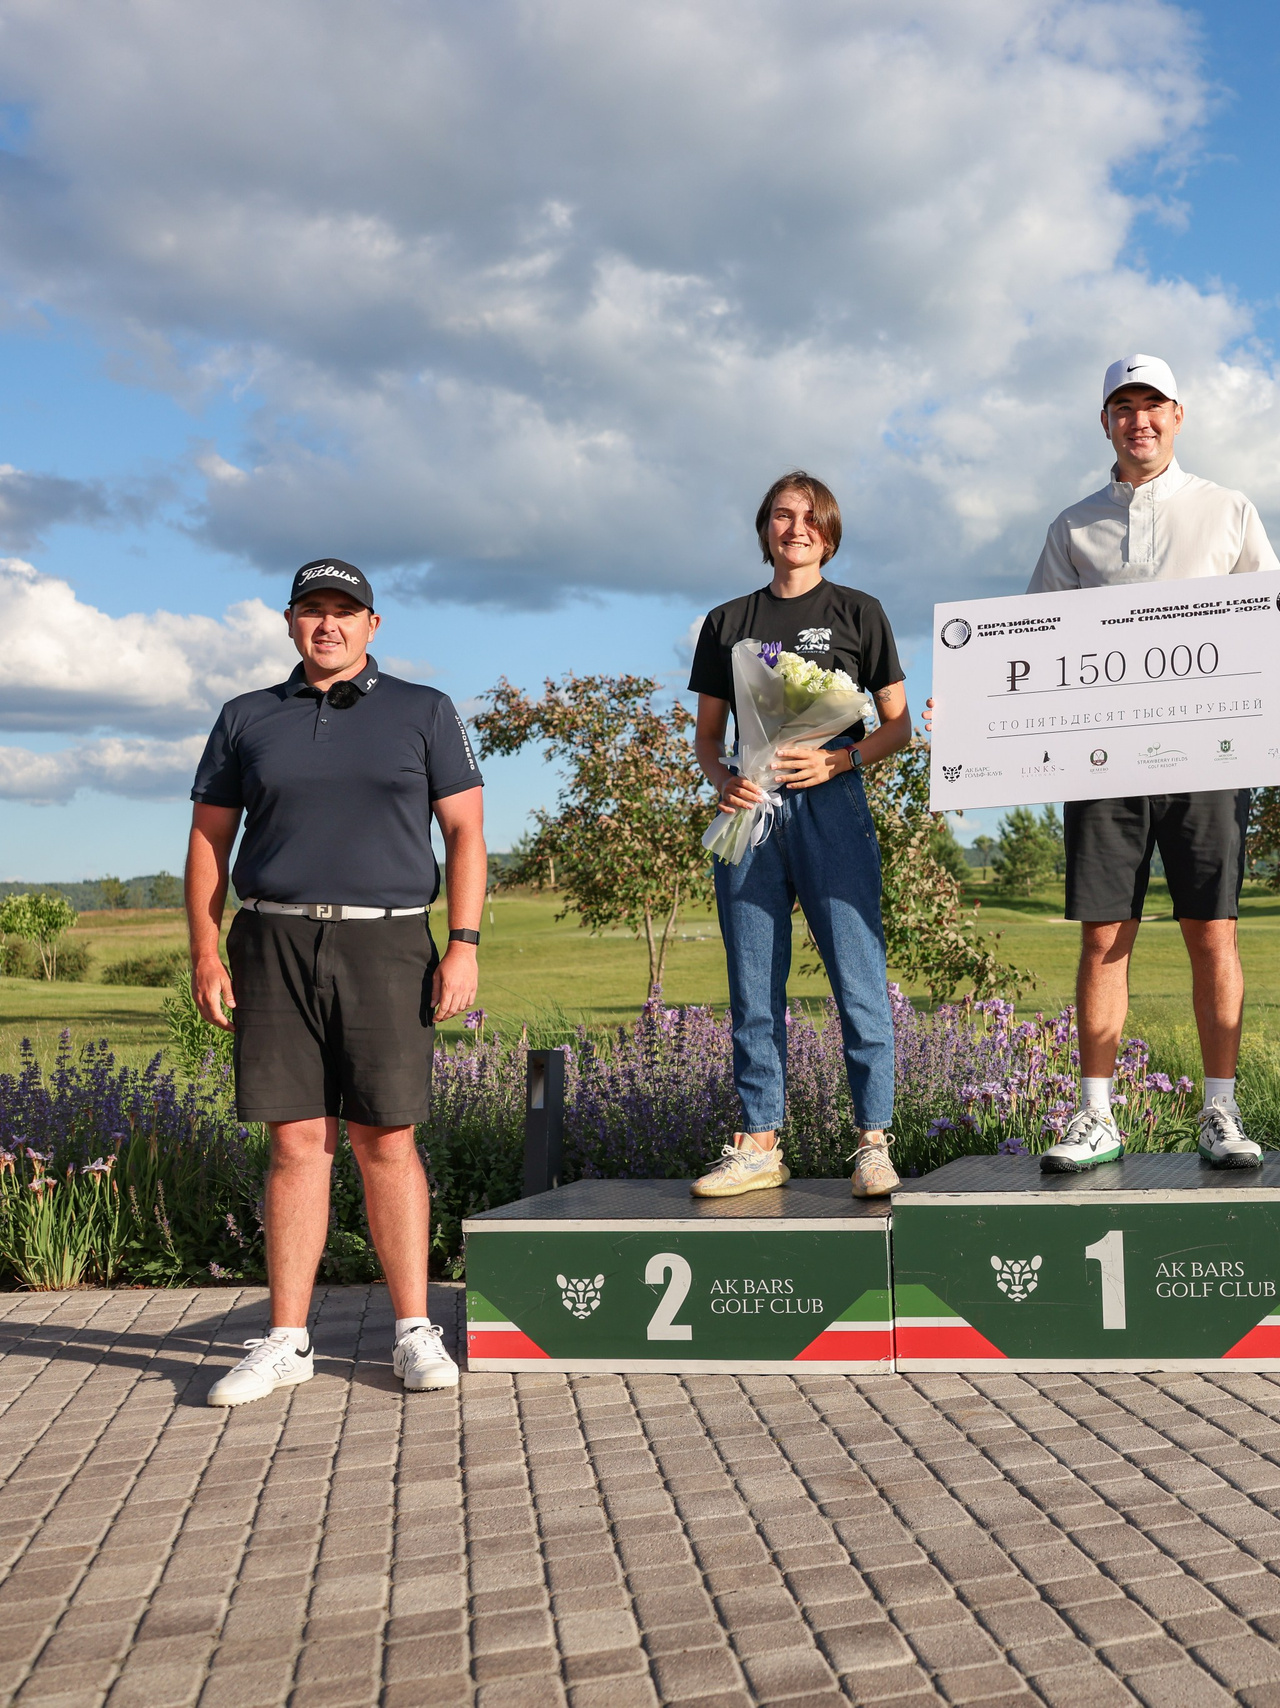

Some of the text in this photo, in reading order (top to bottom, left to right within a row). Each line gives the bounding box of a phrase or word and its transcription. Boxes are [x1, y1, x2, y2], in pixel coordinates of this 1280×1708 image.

[298, 564, 360, 586] Titleist
[1130, 596, 1271, 615] EURASIAN GOLF LEAGUE
[977, 616, 1061, 630] ЕВРАЗИЙСКАЯ
[1100, 604, 1271, 626] TOUR CHAMPIONSHIP 2026
[977, 624, 1056, 637] ЛИГА ГОЛЬФА
[794, 643, 830, 651] VANS
[1056, 650, 1126, 687] 150
[1145, 642, 1219, 679] 000
[988, 699, 1263, 732] СТО ПЯТЬДЕСЯТ ТЫСЯЧ РУБЛЕЙ
[455, 715, 475, 770] J.LINDEBERG
[1021, 765, 1056, 774] LINKS
[316, 904, 332, 918] FJ
[1155, 1261, 1245, 1278] AK BARS
[710, 1278, 794, 1294] AK BARS
[1085, 1230, 1126, 1329] 1
[645, 1252, 692, 1340] 2
[1156, 1281, 1276, 1298] GOLF CLUB
[710, 1298, 824, 1314] GOLF CLUB
